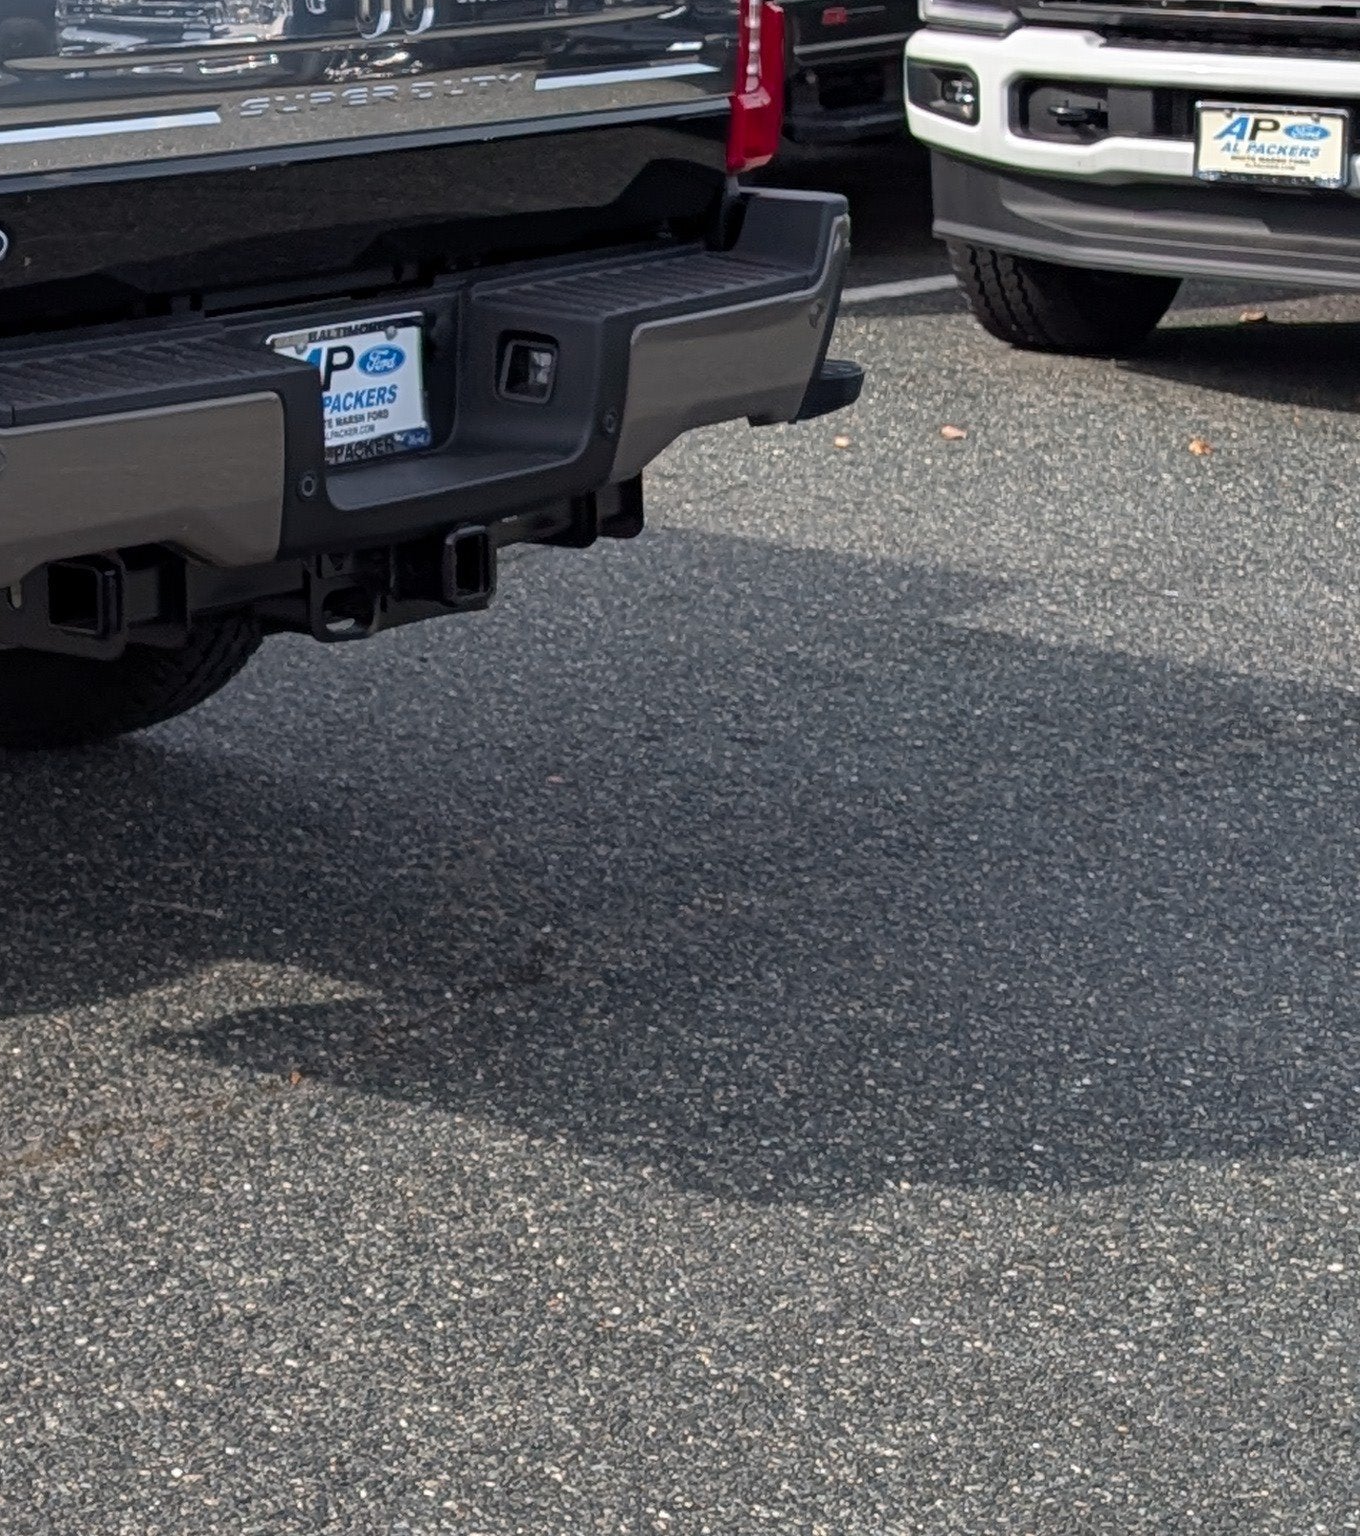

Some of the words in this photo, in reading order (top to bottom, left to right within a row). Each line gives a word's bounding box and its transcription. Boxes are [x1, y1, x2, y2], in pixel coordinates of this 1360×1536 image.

[239, 83, 399, 117] SUPER
[410, 71, 522, 100] DUTY
[1213, 117, 1281, 141] AP
[1220, 143, 1239, 153] AL
[1246, 144, 1321, 159] PACKERS
[322, 384, 398, 414] PACKERS
